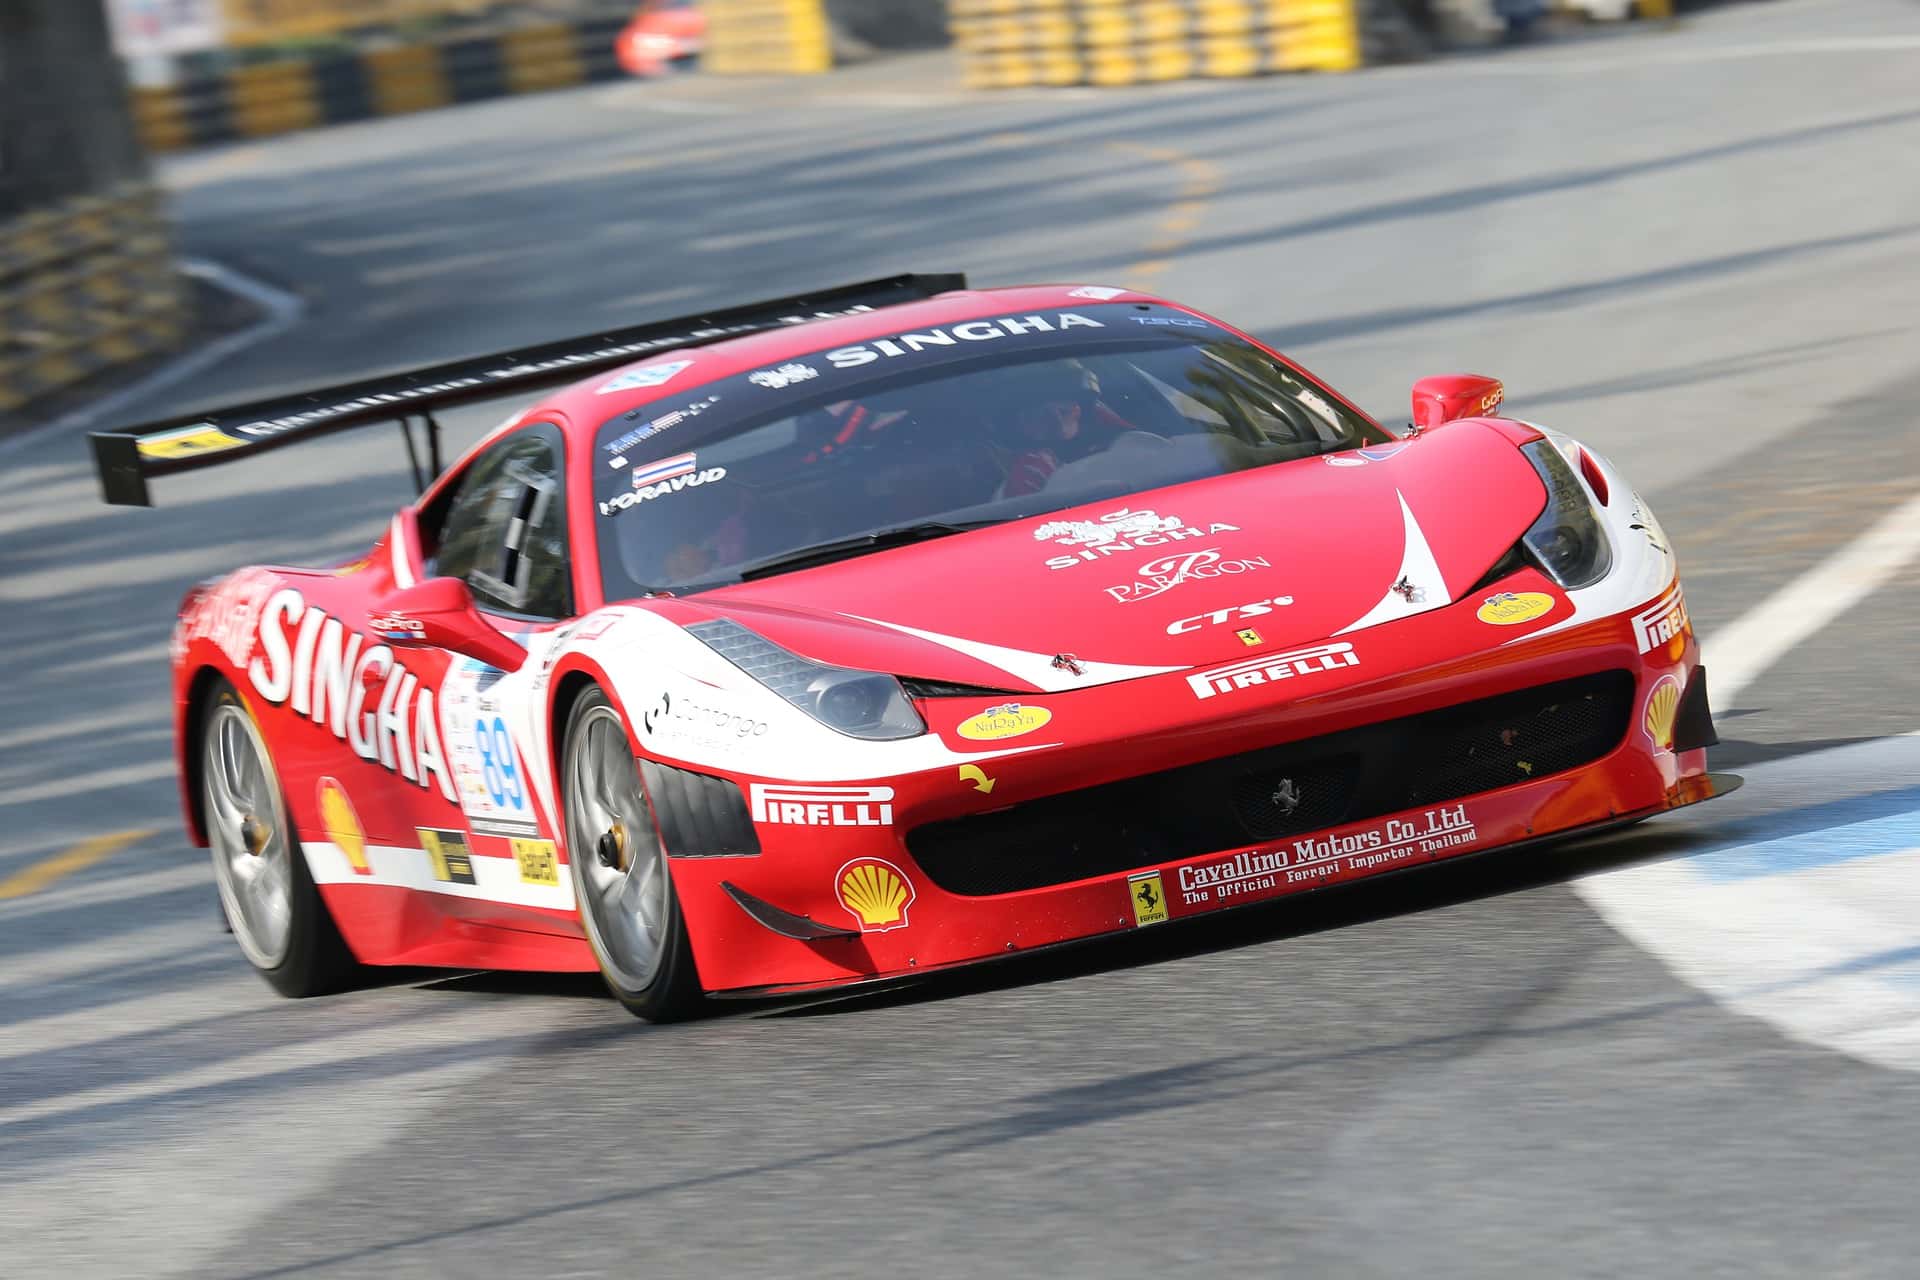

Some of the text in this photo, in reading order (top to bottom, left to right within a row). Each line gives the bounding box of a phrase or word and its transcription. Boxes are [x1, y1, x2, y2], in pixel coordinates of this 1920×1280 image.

[825, 312, 1105, 369] SINGHA
[1045, 522, 1240, 570] SINGHA
[1104, 556, 1271, 603] PARAGON
[1631, 580, 1689, 655] PIREL
[248, 588, 460, 805] SINGHA
[1185, 642, 1361, 699] PIRELLI
[475, 716, 523, 810] 89
[750, 783, 895, 826] PIRELLI
[1179, 851, 1289, 891] Cavallino
[1292, 829, 1382, 864] Motors
[1183, 828, 1478, 904] The Official Ferrari Importer Thailand
